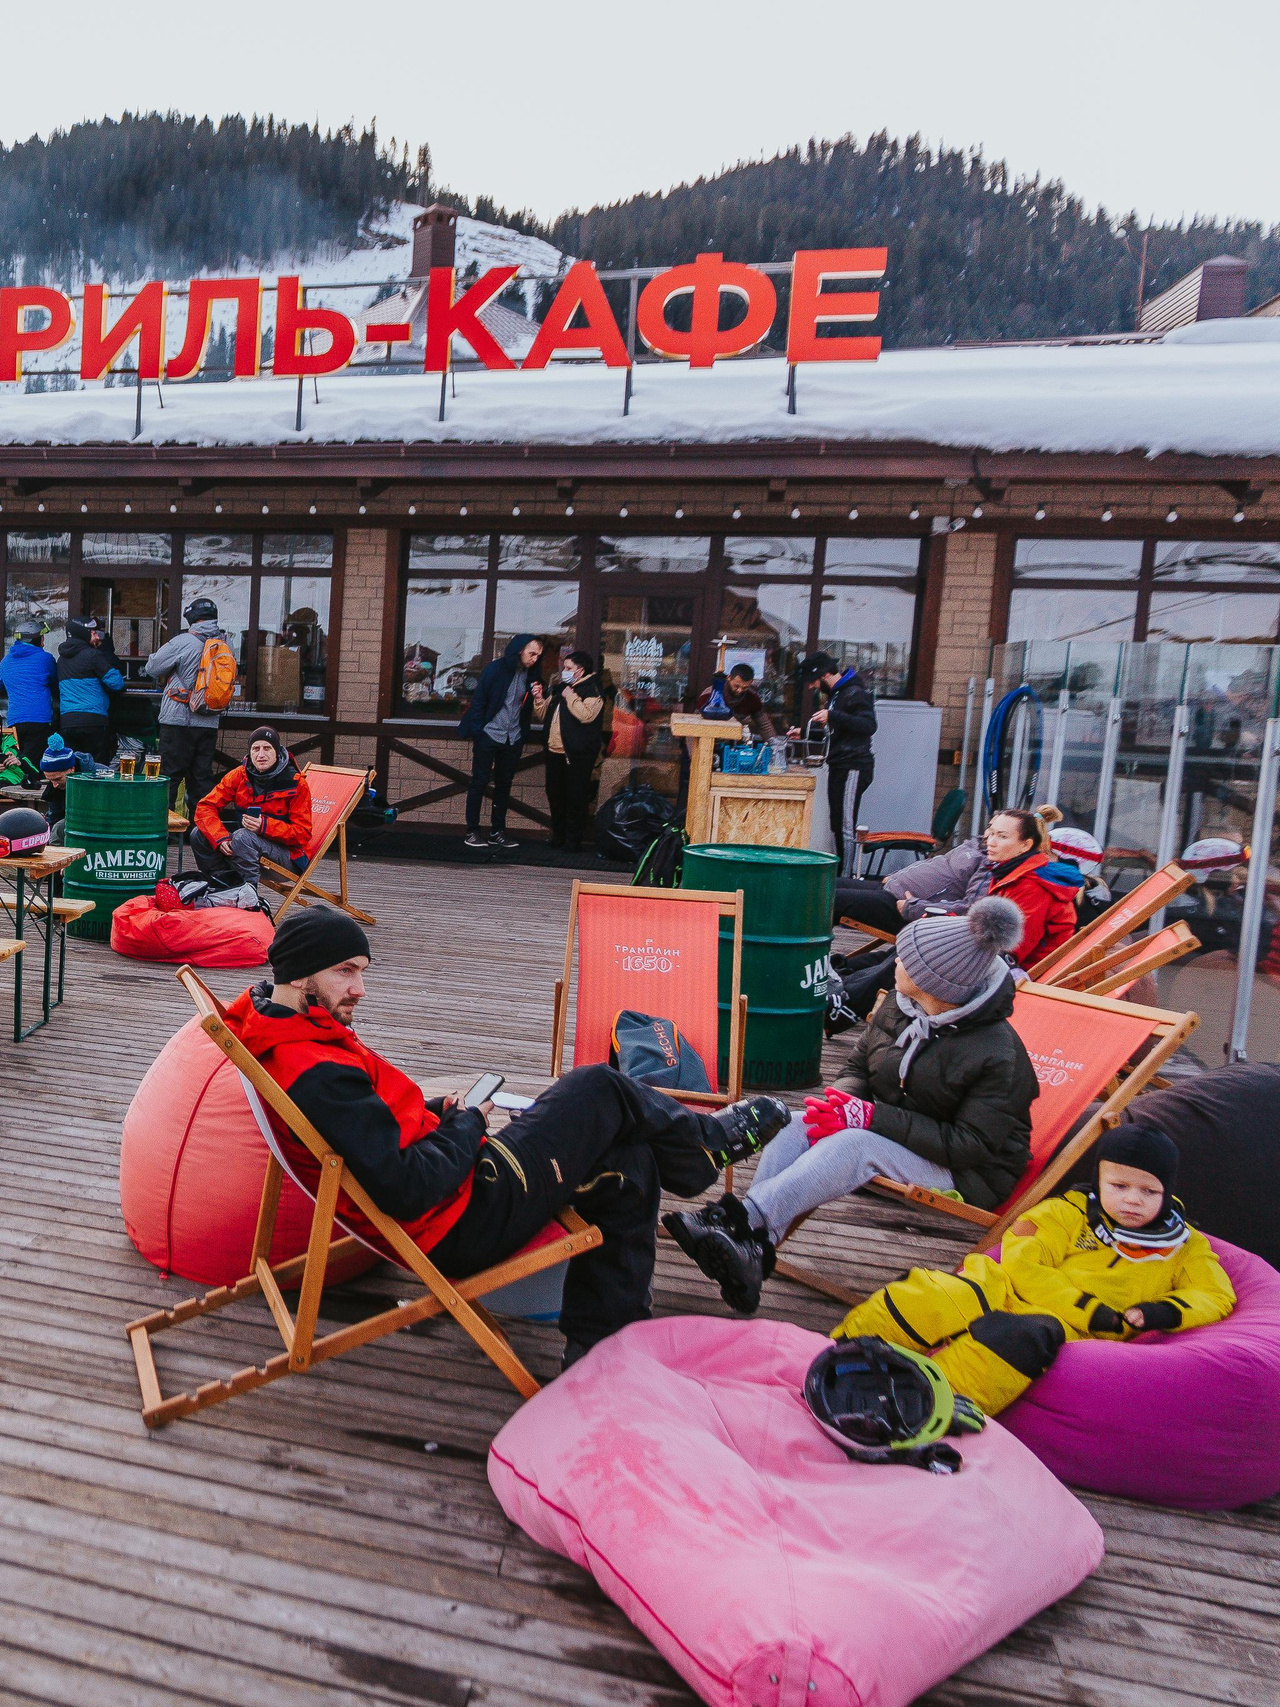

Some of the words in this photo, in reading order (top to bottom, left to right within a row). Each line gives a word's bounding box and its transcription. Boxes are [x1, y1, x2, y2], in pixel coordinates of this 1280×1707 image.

[83, 849, 163, 872] JAMESON
[95, 871, 120, 879] IRISH
[122, 871, 157, 879] WHISKEY
[614, 944, 680, 957] ТРАМПЛИН
[622, 955, 673, 973] 1650
[652, 1021, 677, 1067] SKECHE
[1026, 1050, 1084, 1071] РАМПЛИН
